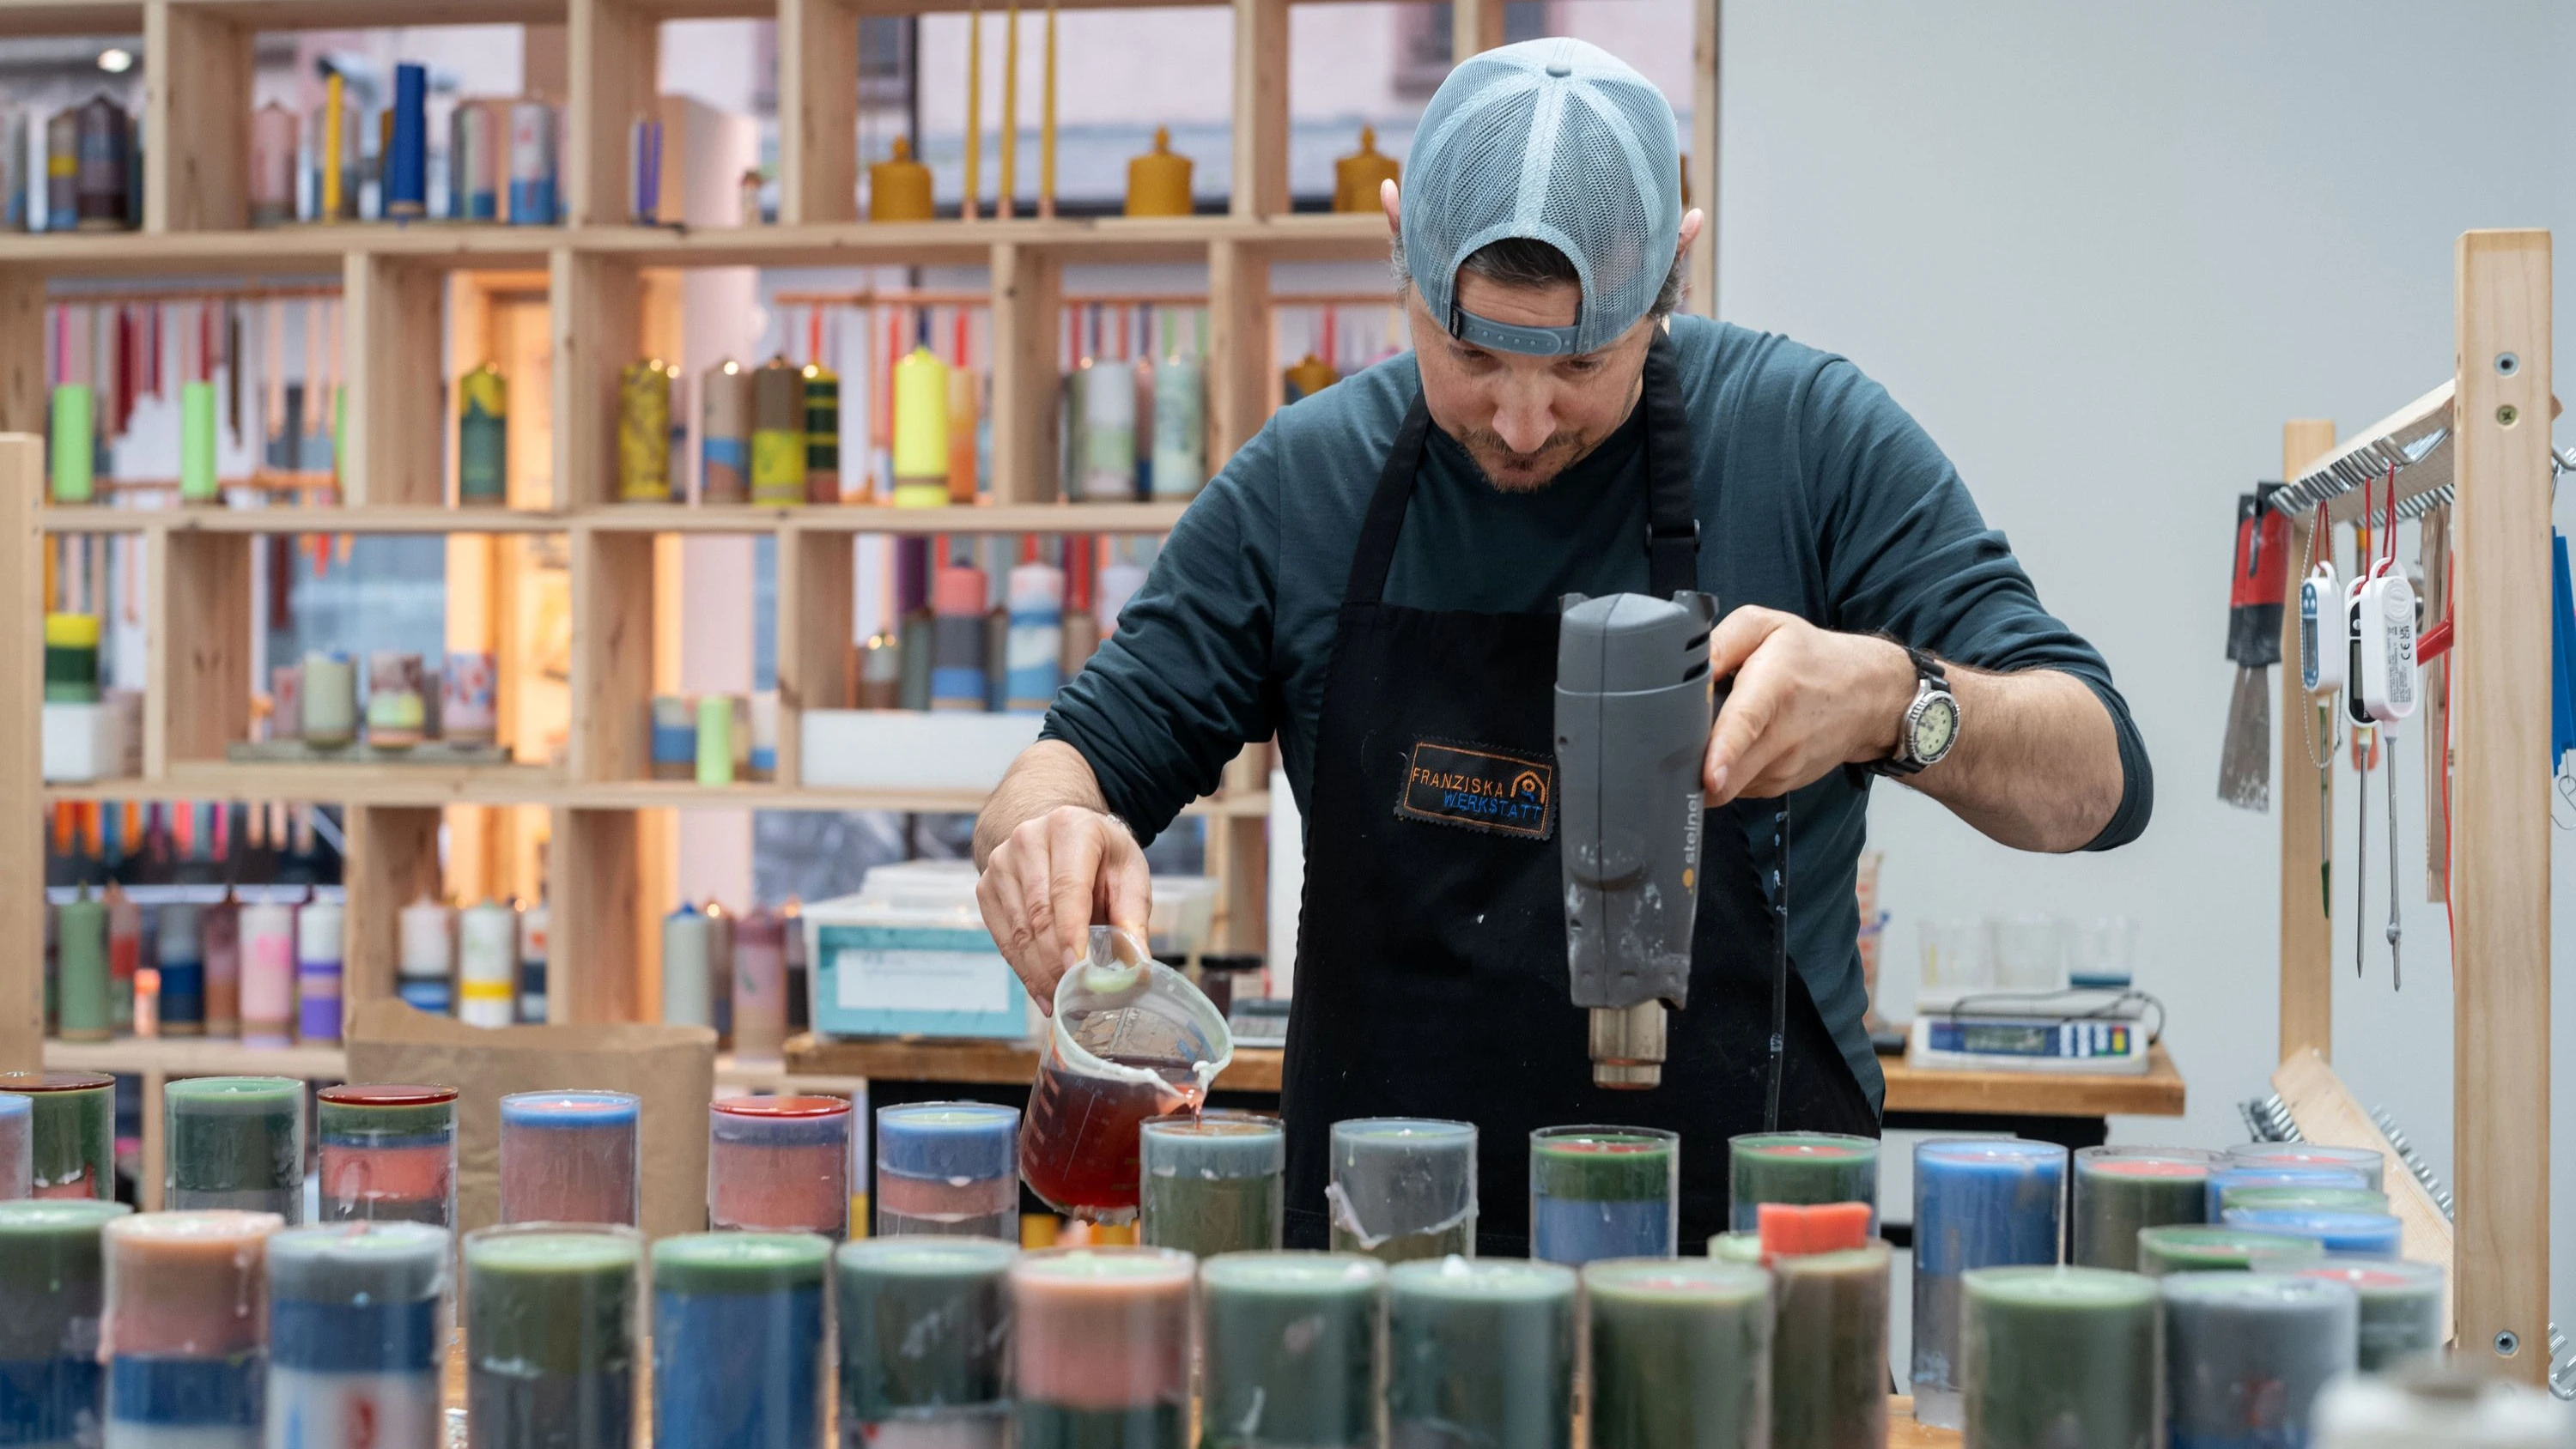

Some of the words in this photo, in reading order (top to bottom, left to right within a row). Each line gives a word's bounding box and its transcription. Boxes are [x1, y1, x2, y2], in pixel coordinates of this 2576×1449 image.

[2401, 643, 2411, 660] CE
[1413, 767, 1504, 797] FRANZISKA
[1443, 790, 1543, 821] WERKSTATT
[1683, 793, 1699, 864] steinel
